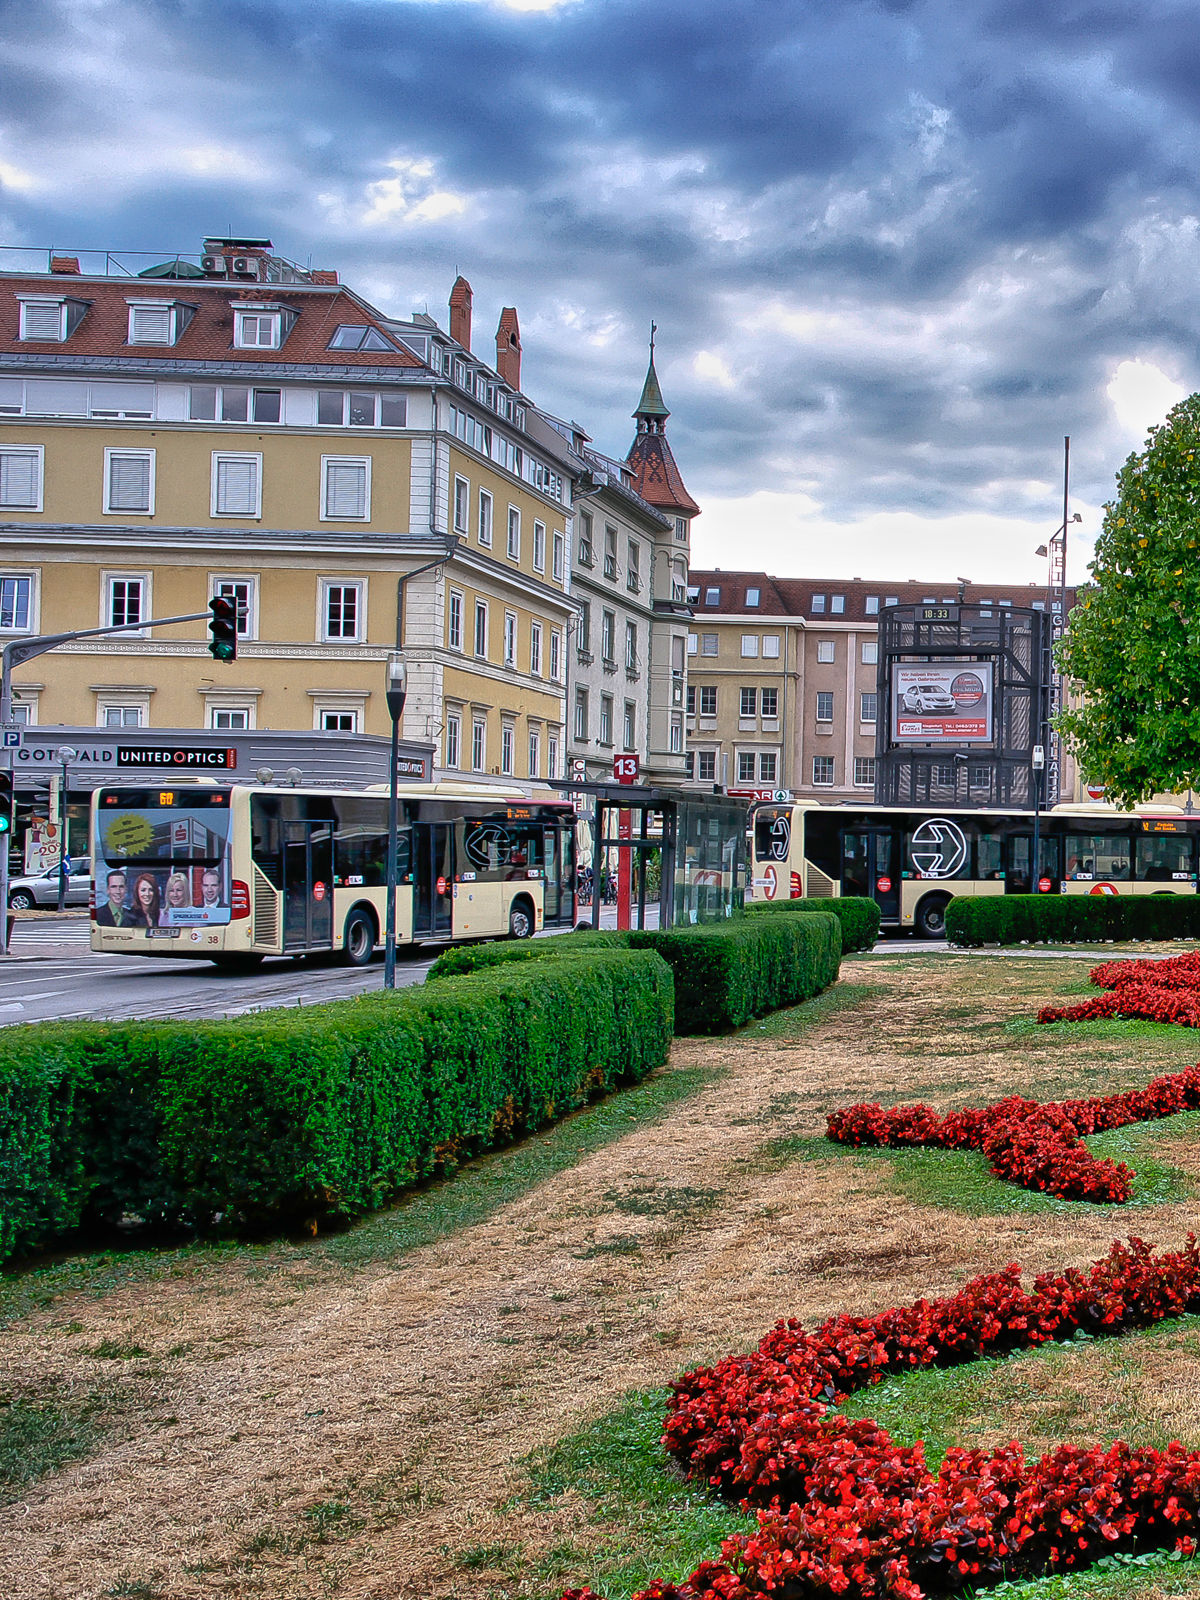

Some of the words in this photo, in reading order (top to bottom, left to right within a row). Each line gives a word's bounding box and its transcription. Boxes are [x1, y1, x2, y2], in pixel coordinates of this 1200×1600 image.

[924, 609, 948, 618] 18:33
[7, 733, 18, 746] P
[18, 748, 113, 762] GOTALD
[614, 759, 637, 776] 13
[207, 935, 219, 944] 38
